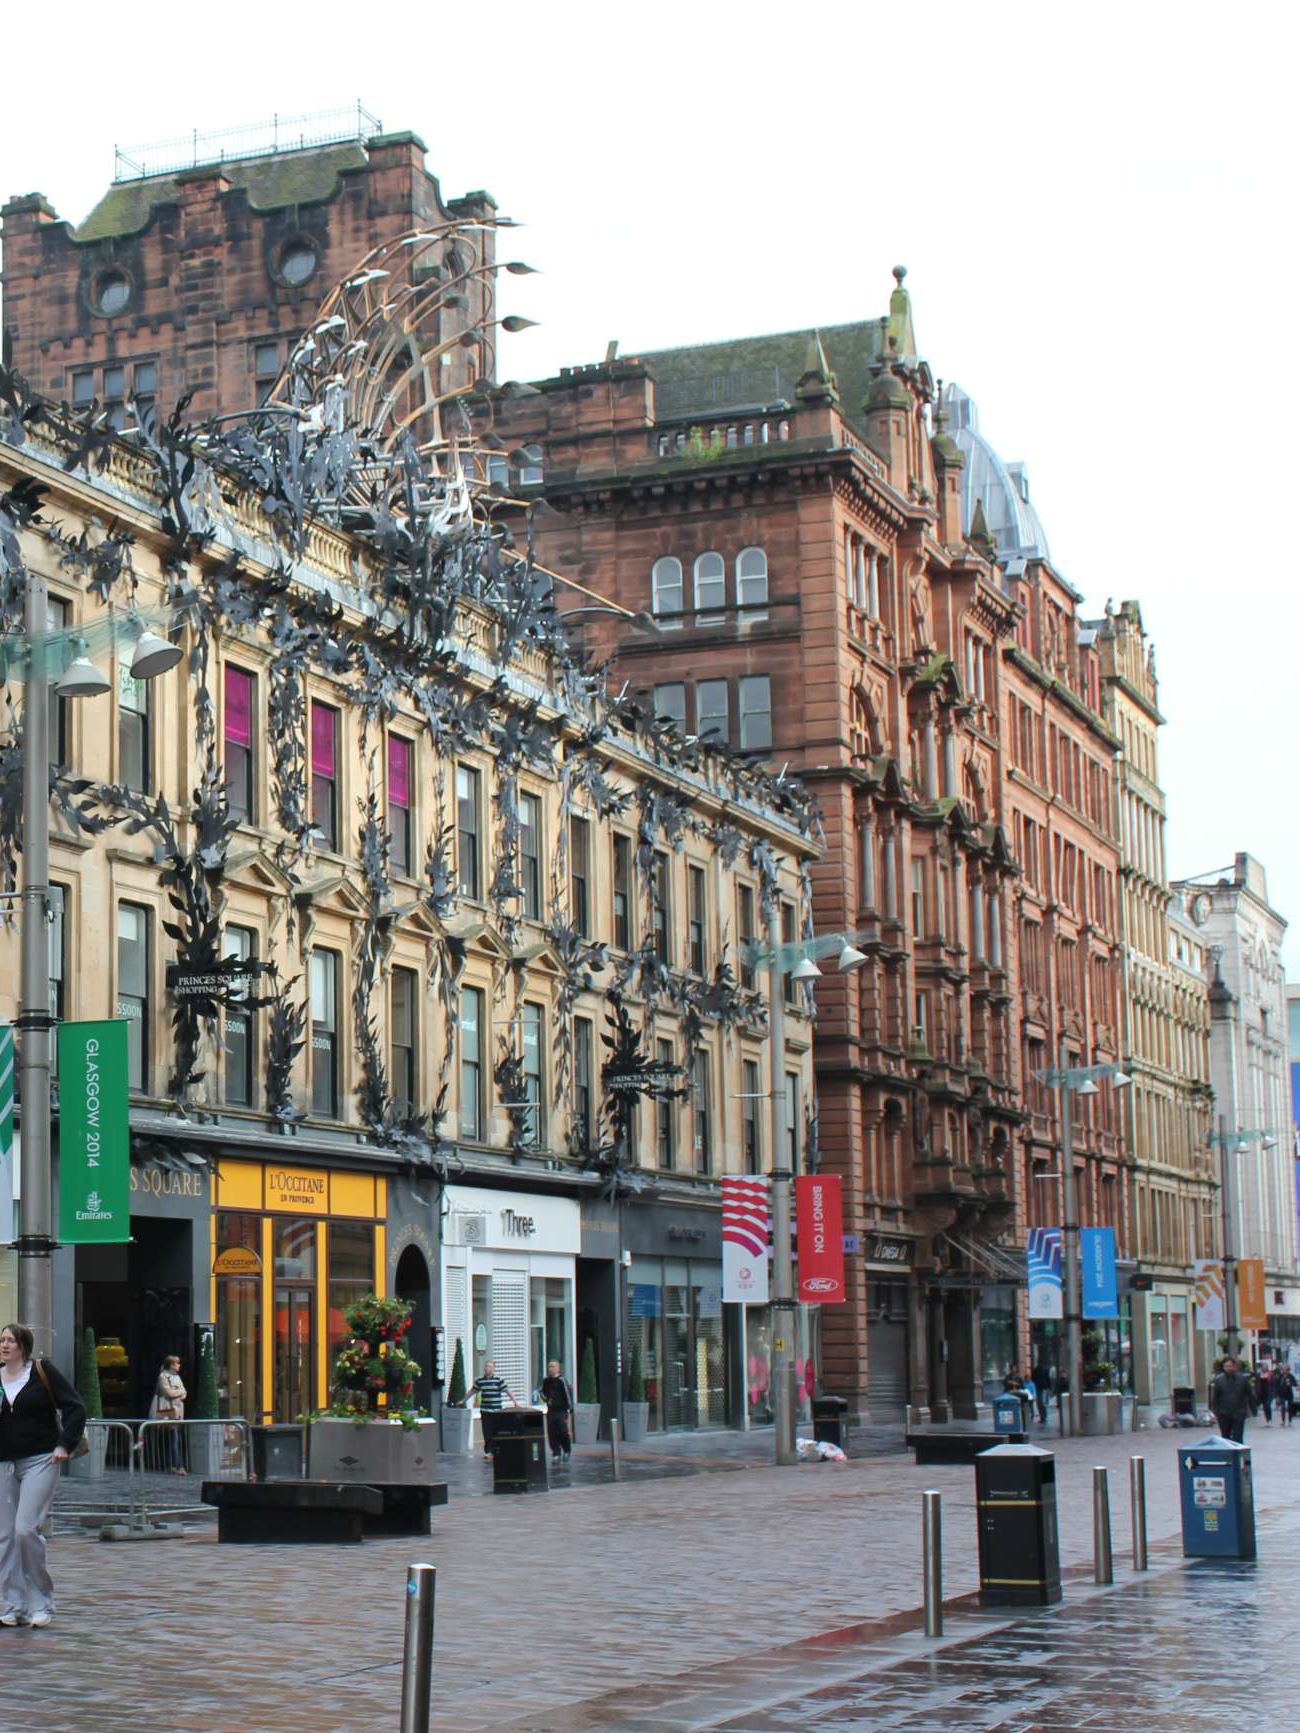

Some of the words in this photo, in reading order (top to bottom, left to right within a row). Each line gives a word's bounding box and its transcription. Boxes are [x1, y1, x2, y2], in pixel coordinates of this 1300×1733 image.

[177, 985, 217, 994] SHOPPING
[178, 975, 216, 986] PRINCES
[217, 974, 253, 985] SQUARE
[85, 1038, 100, 1128] GLASGOW
[86, 1132, 100, 1168] 2014
[142, 1168, 202, 1200] SQUARE
[269, 1171, 325, 1194] L'OCCITANE
[812, 1185, 824, 1220] BRING
[76, 1210, 113, 1221] Emirates
[814, 1222, 824, 1233] IT
[814, 1235, 825, 1254] ON
[808, 1279, 833, 1291] Ford
